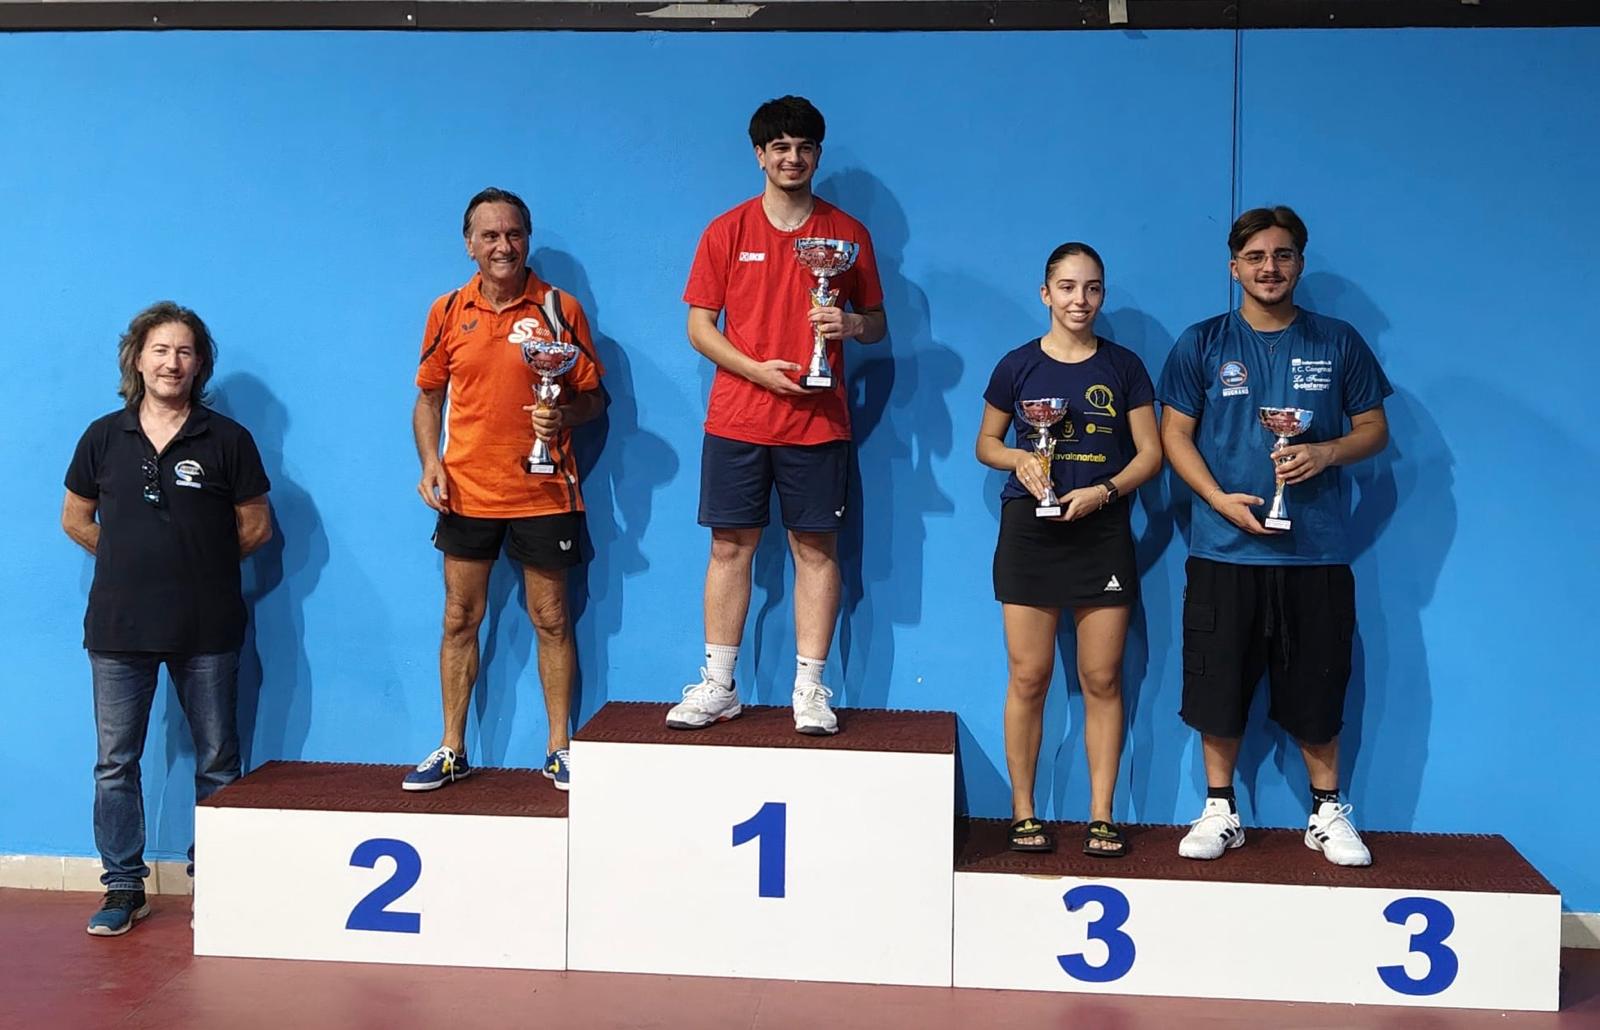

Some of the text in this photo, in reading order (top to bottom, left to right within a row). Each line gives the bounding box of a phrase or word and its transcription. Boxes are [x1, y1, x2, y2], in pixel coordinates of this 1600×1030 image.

[345, 838, 421, 933] 2
[732, 802, 787, 898] 1
[1057, 884, 1136, 983] 3
[1376, 896, 1459, 996] 3
